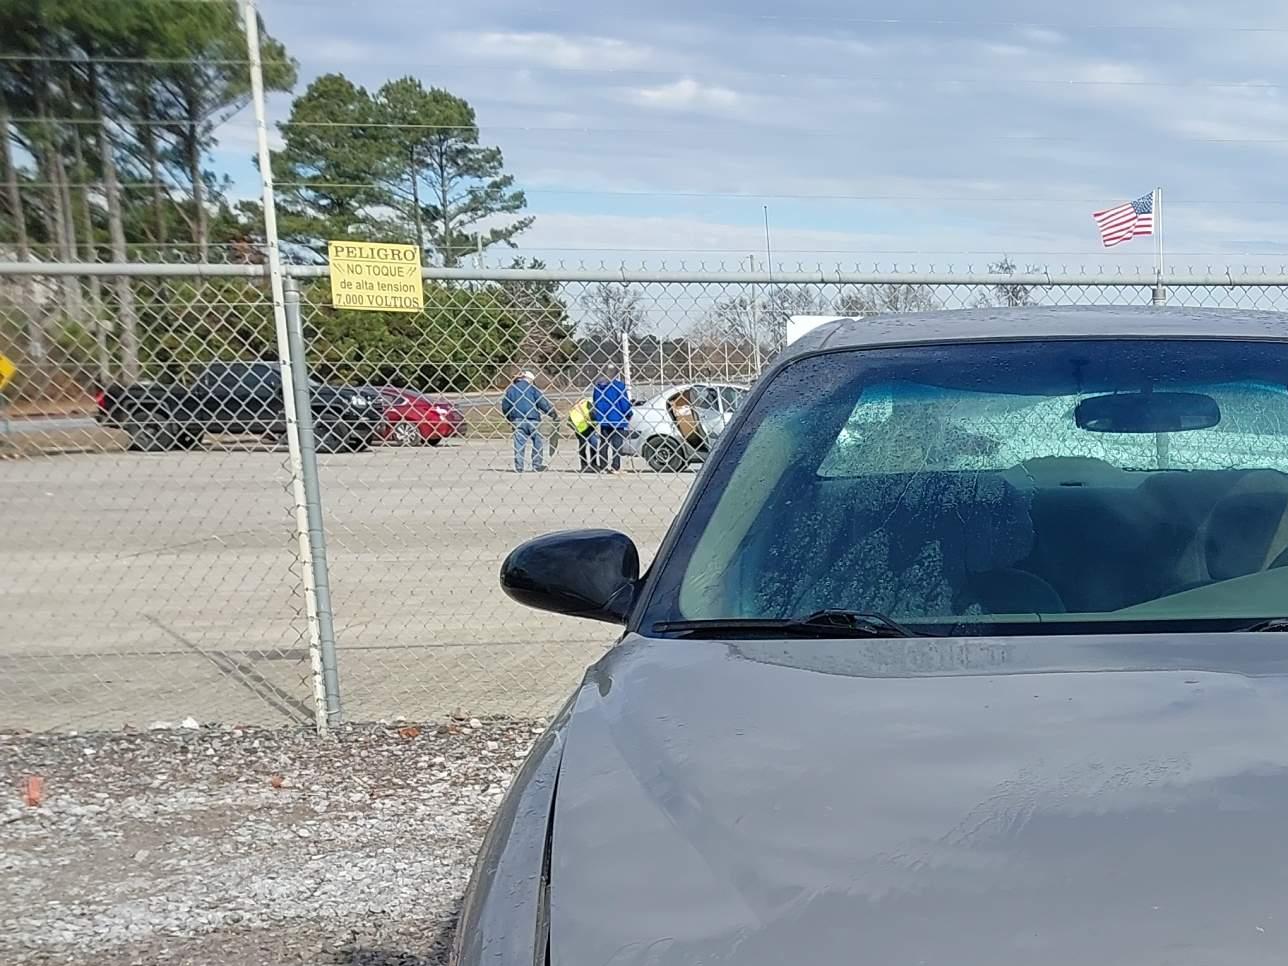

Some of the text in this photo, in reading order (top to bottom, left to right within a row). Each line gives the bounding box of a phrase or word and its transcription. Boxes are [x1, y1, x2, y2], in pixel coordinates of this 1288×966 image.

[334, 245, 416, 261] PELIGRO
[347, 264, 405, 278] NO TOQUE
[340, 279, 416, 293] de alta tension
[367, 295, 419, 308] VOLTIOS
